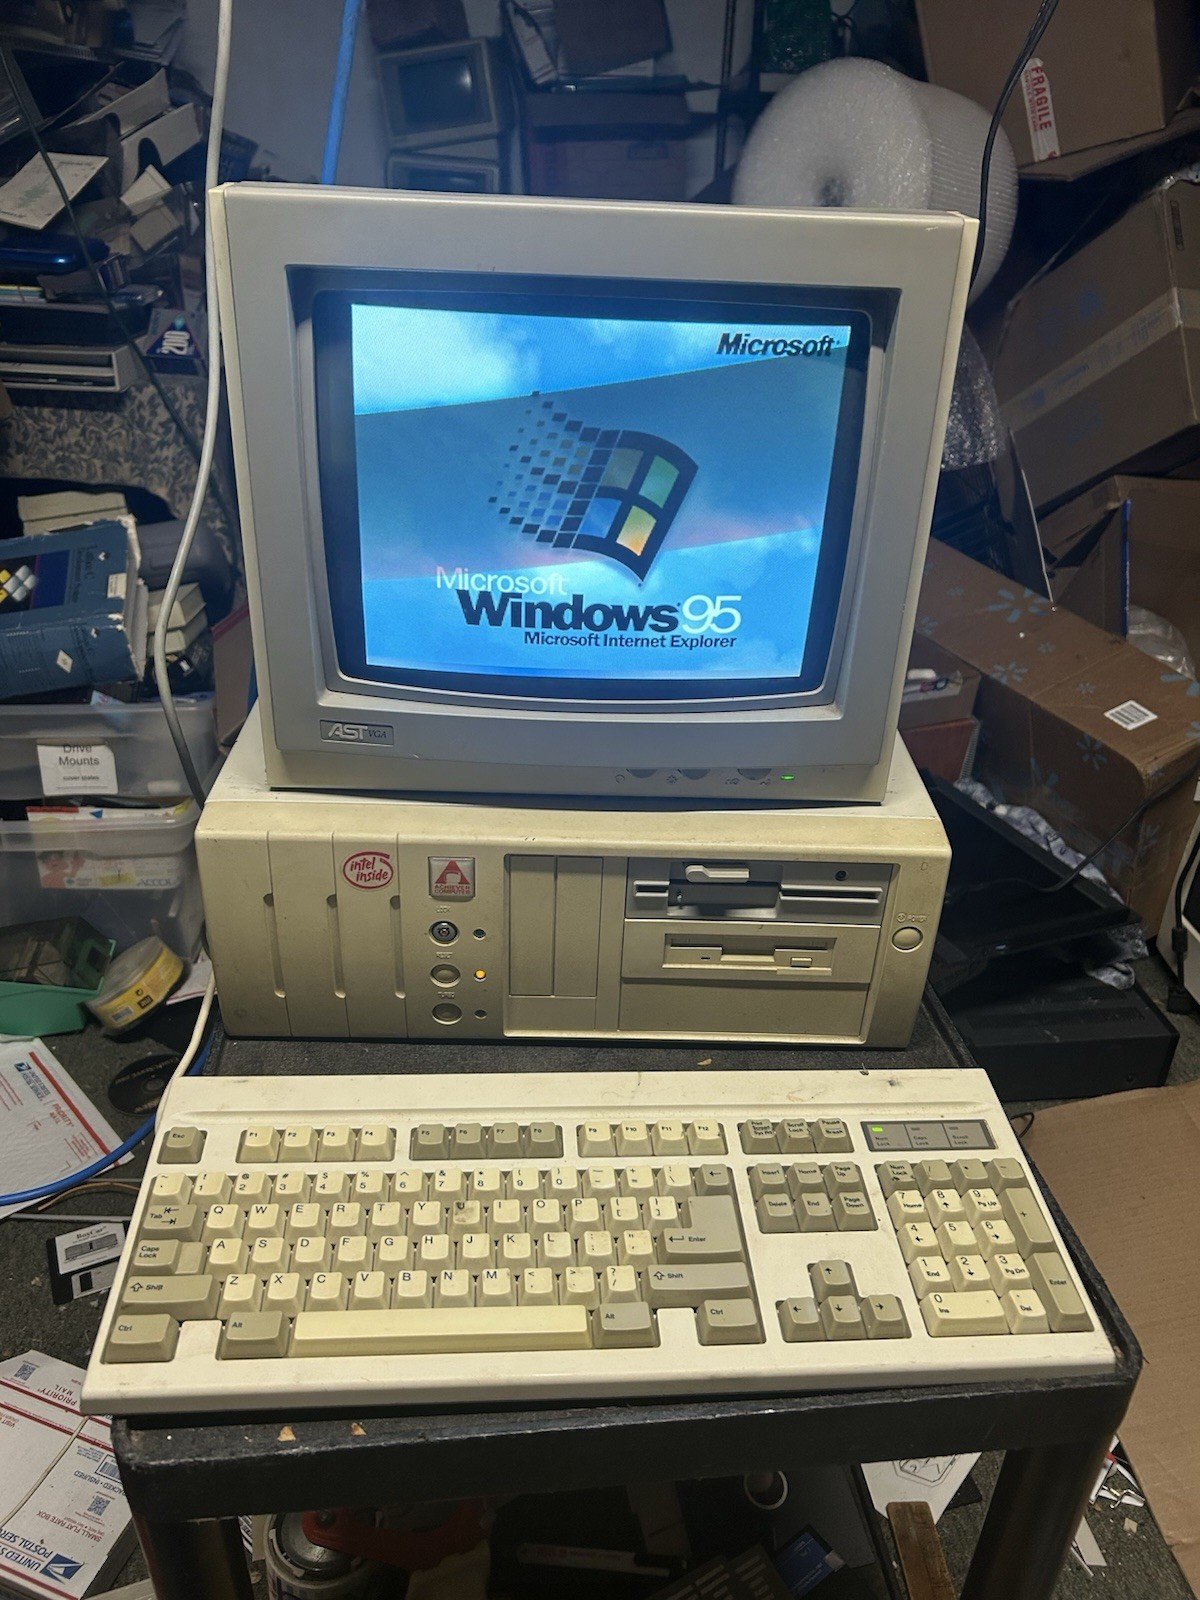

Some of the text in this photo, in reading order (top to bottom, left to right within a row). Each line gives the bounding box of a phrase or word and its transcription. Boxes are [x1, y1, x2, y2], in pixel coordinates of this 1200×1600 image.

[1031, 66, 1052, 130] FRAGILE
[716, 332, 834, 358] Microsoft
[436, 565, 569, 597] Microsoft
[456, 588, 742, 634] Windows 95
[523, 630, 737, 651] Microsoft Internet Explorer
[328, 722, 387, 740] AST VGA
[63, 743, 92, 753] Drive
[58, 756, 100, 766] Mounts
[350, 856, 376, 872] intel
[356, 868, 389, 883] inside
[399, 1181, 407, 1189] 6
[438, 1180, 445, 1188] 7
[477, 1179, 485, 1187] 8
[517, 1179, 524, 1187] 9
[555, 1178, 563, 1186] 0
[238, 1183, 247, 1191] 2
[279, 1183, 287, 1191] 3
[318, 1183, 327, 1191] 4
[900, 1191, 906, 1199] 7
[936, 1190, 945, 1199] 8
[972, 1189, 981, 1198] 9
[377, 1203, 386, 1211] T
[417, 1202, 426, 1211] Y
[536, 1200, 546, 1209] O
[574, 1199, 583, 1207] P
[977, 1200, 998, 1208] Pg Up
[213, 1205, 225, 1215] Q
[254, 1205, 268, 1214] W
[295, 1205, 304, 1214] E
[336, 1204, 346, 1213] R
[910, 1224, 918, 1232] 4
[949, 1223, 957, 1232] 5
[985, 1222, 994, 1230] 6
[341, 1238, 350, 1246] F
[384, 1238, 395, 1247] G
[424, 1236, 434, 1244] H
[466, 1236, 474, 1244] J
[506, 1234, 516, 1243] K
[547, 1234, 555, 1242] L
[215, 1239, 226, 1249] A
[258, 1239, 268, 1248] S
[300, 1239, 310, 1248] D
[138, 1252, 158, 1260] Lock
[1000, 1256, 1008, 1265] 3
[921, 1258, 928, 1267] 1
[960, 1256, 970, 1266] 2
[443, 1272, 453, 1280] N
[486, 1271, 498, 1279] M
[926, 1270, 940, 1278] End
[1005, 1268, 1015, 1276] Pg
[229, 1276, 239, 1286] Z
[273, 1275, 284, 1284] X
[316, 1274, 326, 1284] C
[360, 1274, 370, 1283] V
[402, 1272, 412, 1282] B
[145, 1283, 164, 1291] Shift
[934, 1293, 943, 1303] 0
[604, 1312, 615, 1320] Alt
[117, 1324, 133, 1332] Ctrl
[231, 1321, 243, 1329] Alt
[55, 1384, 74, 1396] MAIL
[41, 1388, 78, 1406] PRIORITY
[74, 1470, 100, 1485] INSURED
[36, 1510, 51, 1521] BOX
[50, 1516, 67, 1527] RATE
[65, 1522, 81, 1534] FLAT
[82, 1529, 102, 1543] SMALL
[18, 1537, 54, 1559] POSTAL
[5, 1549, 41, 1572] UNITED
